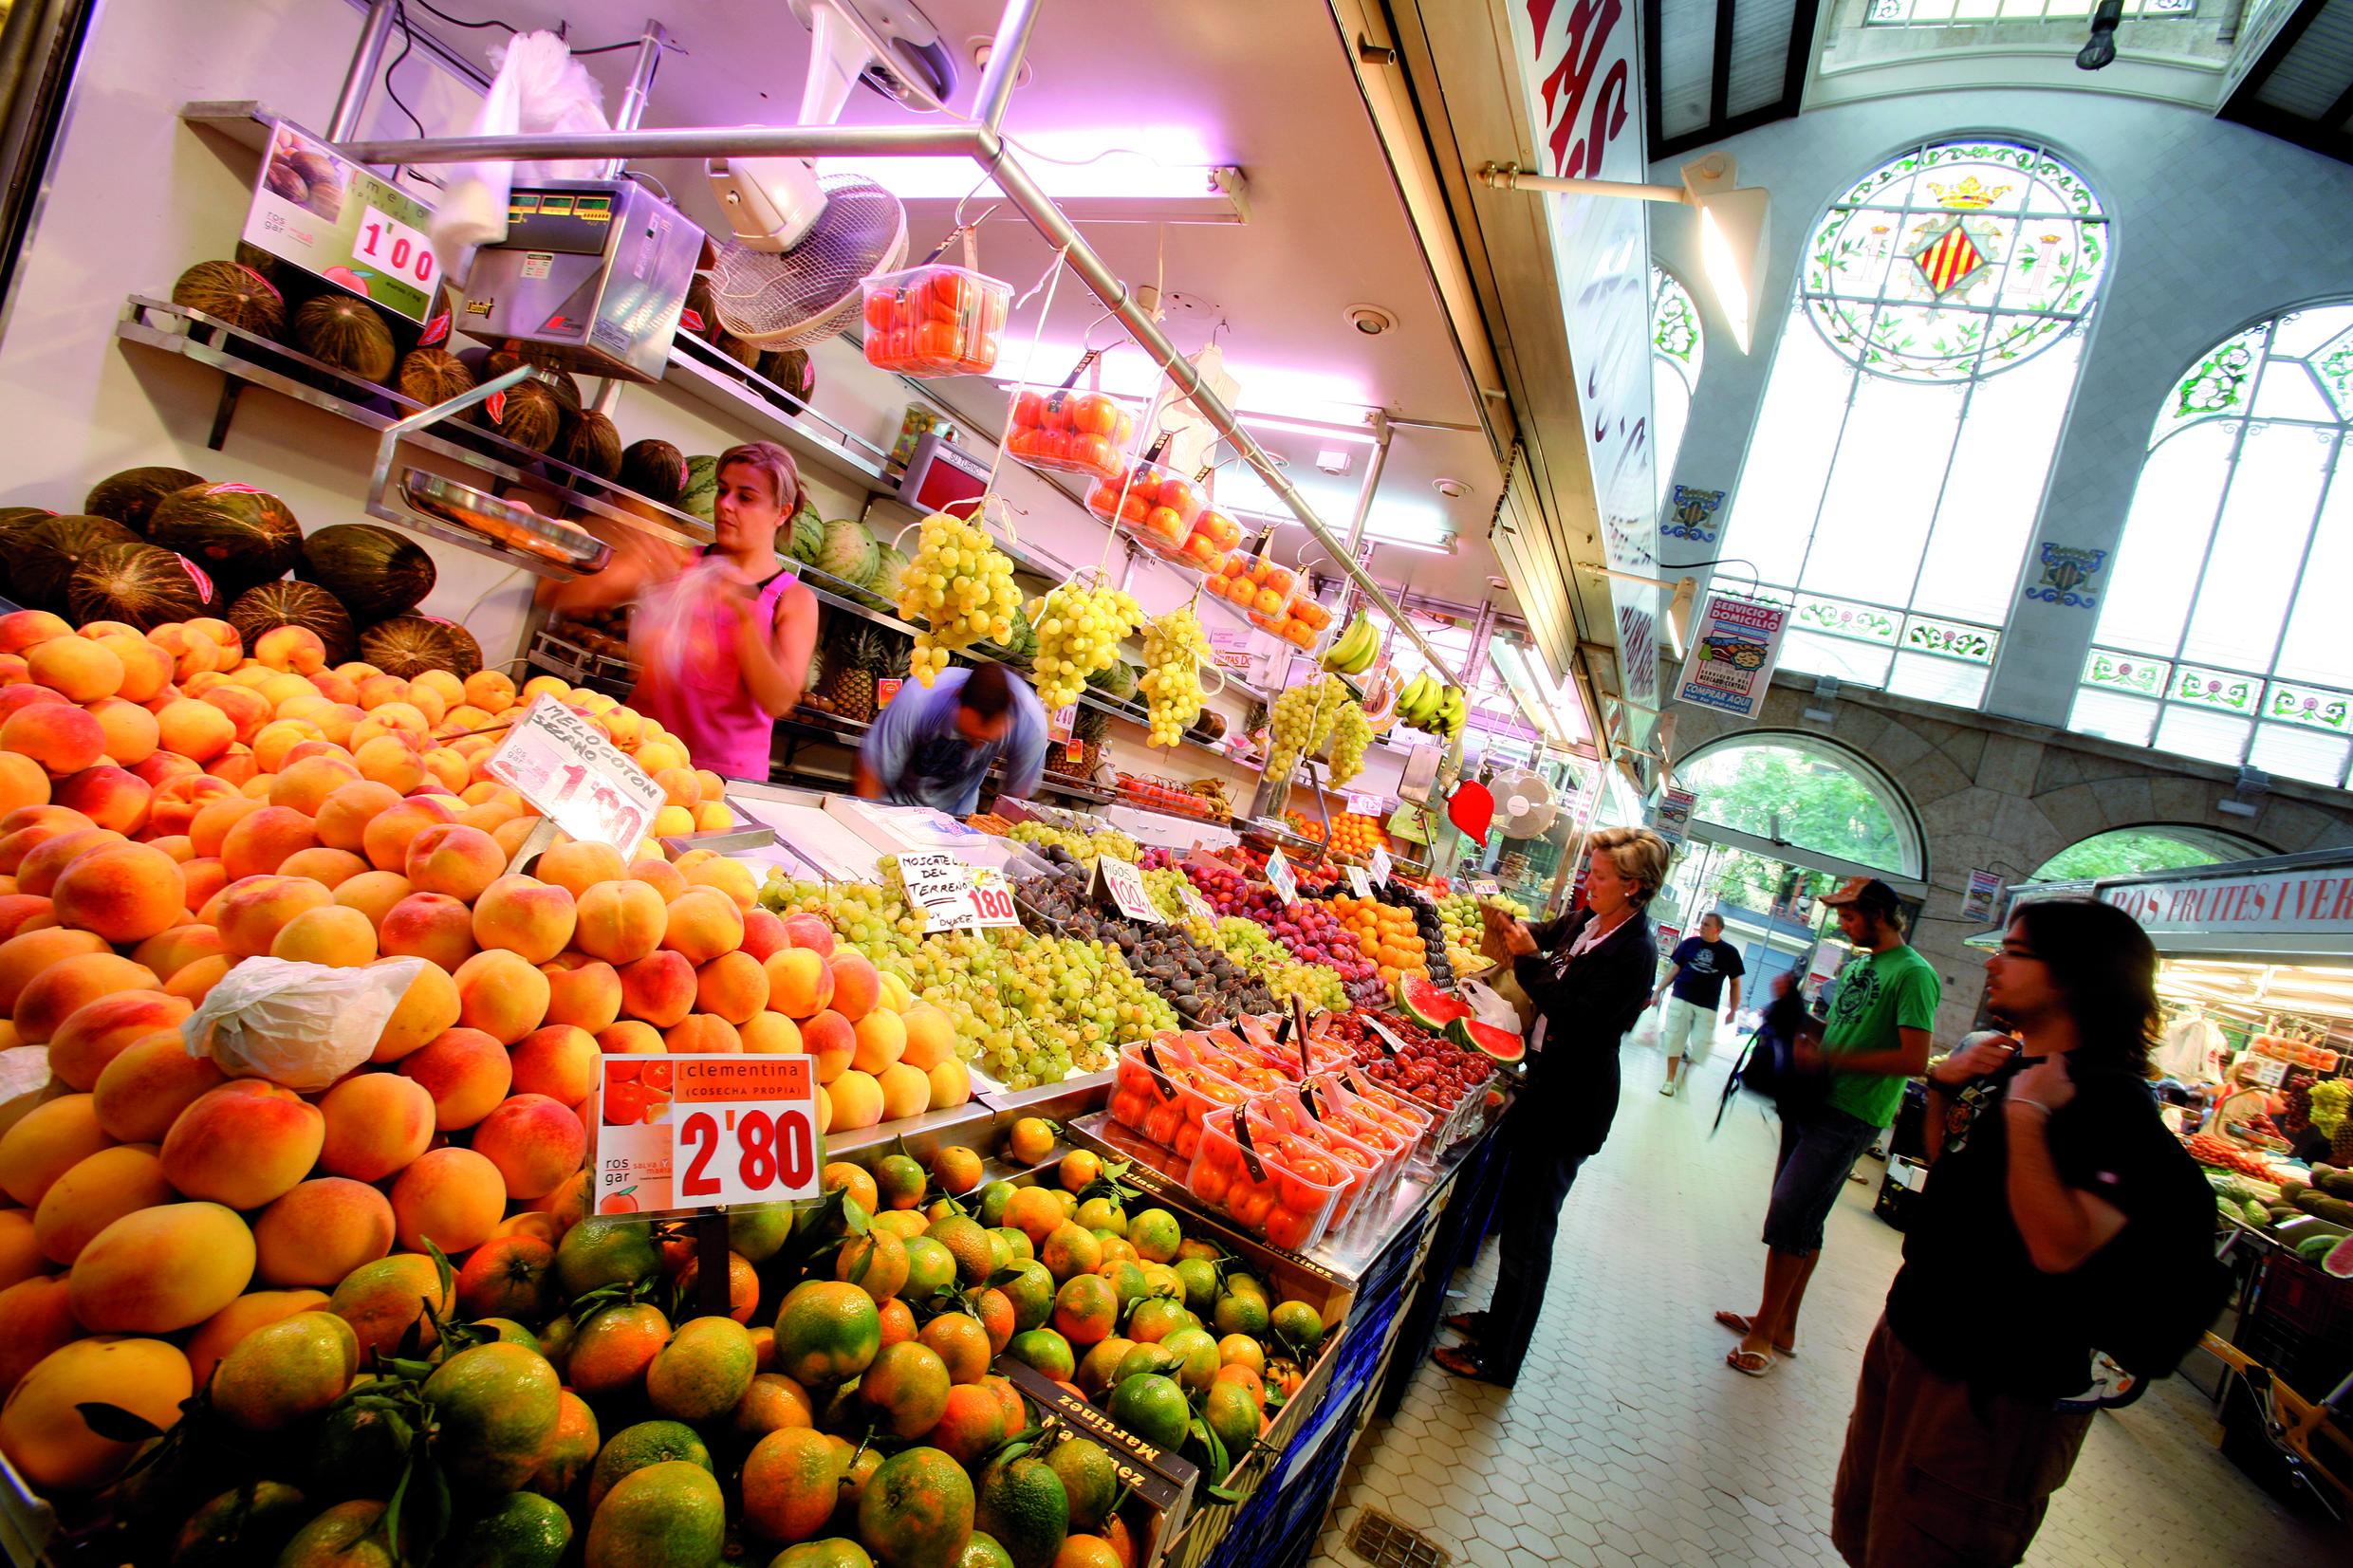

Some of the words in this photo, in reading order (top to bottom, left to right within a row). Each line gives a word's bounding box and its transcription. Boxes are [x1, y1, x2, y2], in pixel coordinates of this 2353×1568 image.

[267, 211, 286, 225] ros
[265, 221, 284, 233] gar
[949, 453, 959, 462] SU
[958, 458, 981, 474] TURNO
[1714, 600, 1768, 618] SERVICIO
[1769, 612, 1779, 621] A
[1712, 610, 1778, 631] DOMICILIO
[1685, 684, 1727, 701] COMPRAR
[902, 855, 957, 867] MOSCATEL
[921, 868, 947, 878] DEL
[1102, 859, 1132, 880] HIGOS
[908, 882, 968, 897] TERRENO
[2166, 882, 2270, 923] FRUITES
[2270, 880, 2291, 921] I
[686, 1087, 748, 1098] (COSECHA
[752, 1086, 802, 1096] PROPIA)
[680, 1109, 814, 1197] 2'80
[605, 1158, 629, 1170] ros
[605, 1171, 630, 1186] gar
